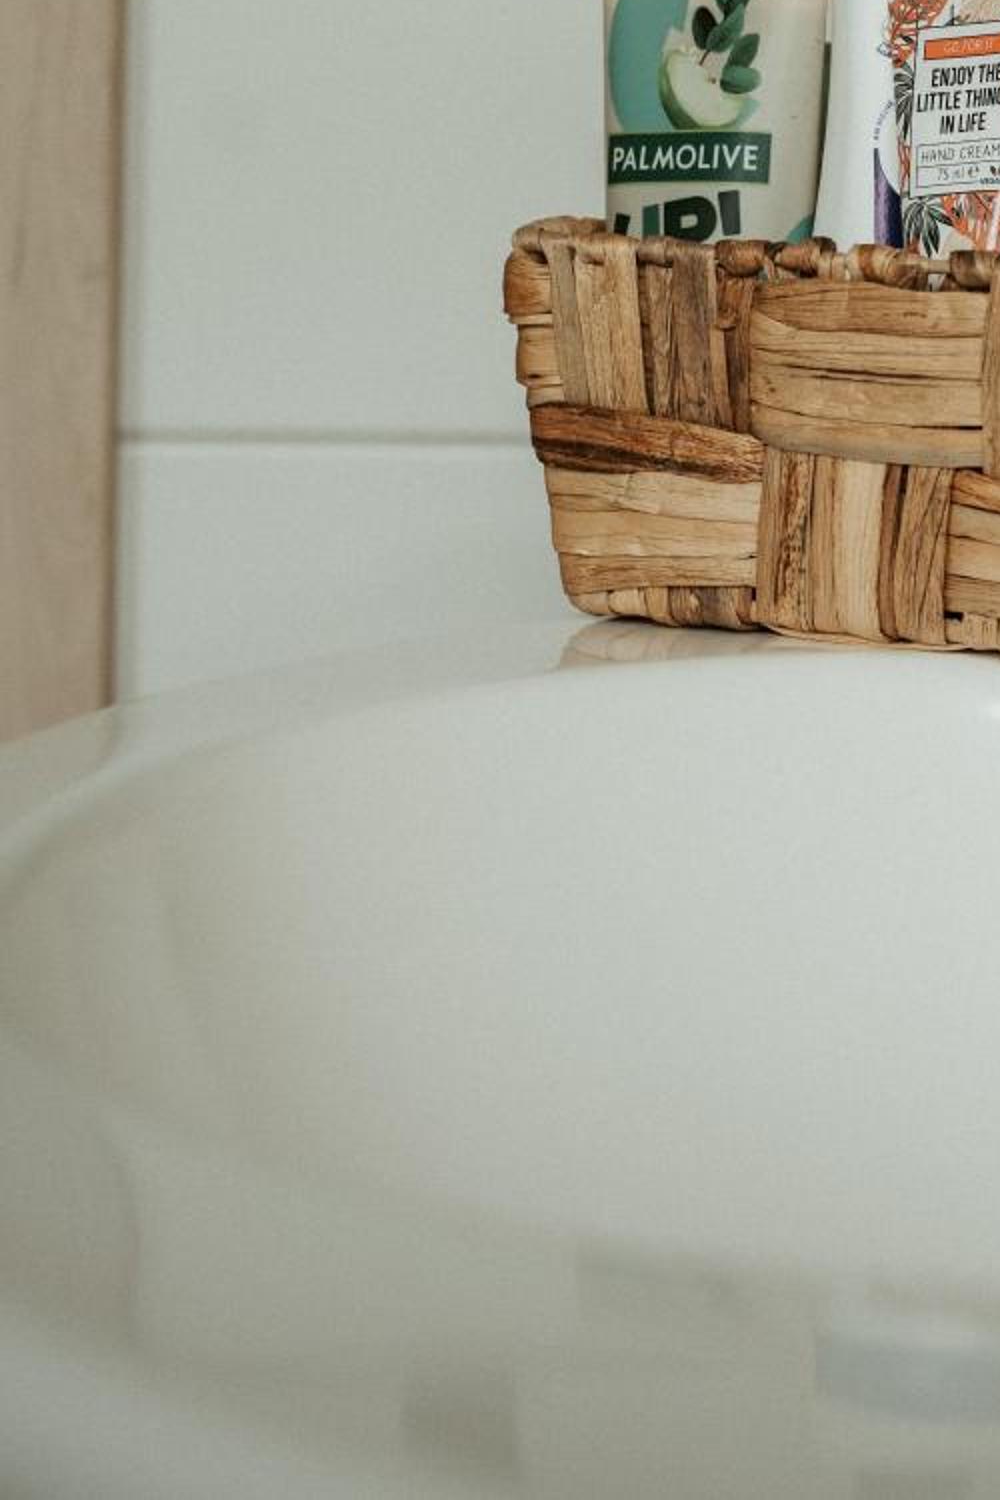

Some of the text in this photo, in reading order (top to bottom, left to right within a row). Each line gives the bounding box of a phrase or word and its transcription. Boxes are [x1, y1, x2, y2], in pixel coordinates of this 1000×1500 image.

[931, 65, 975, 88] ENJOY
[916, 90, 962, 113] LITTLE
[940, 111, 987, 135] IN LIFE
[612, 144, 760, 172] PALMOLIVE
[921, 143, 1000, 163] HAND CREAM
